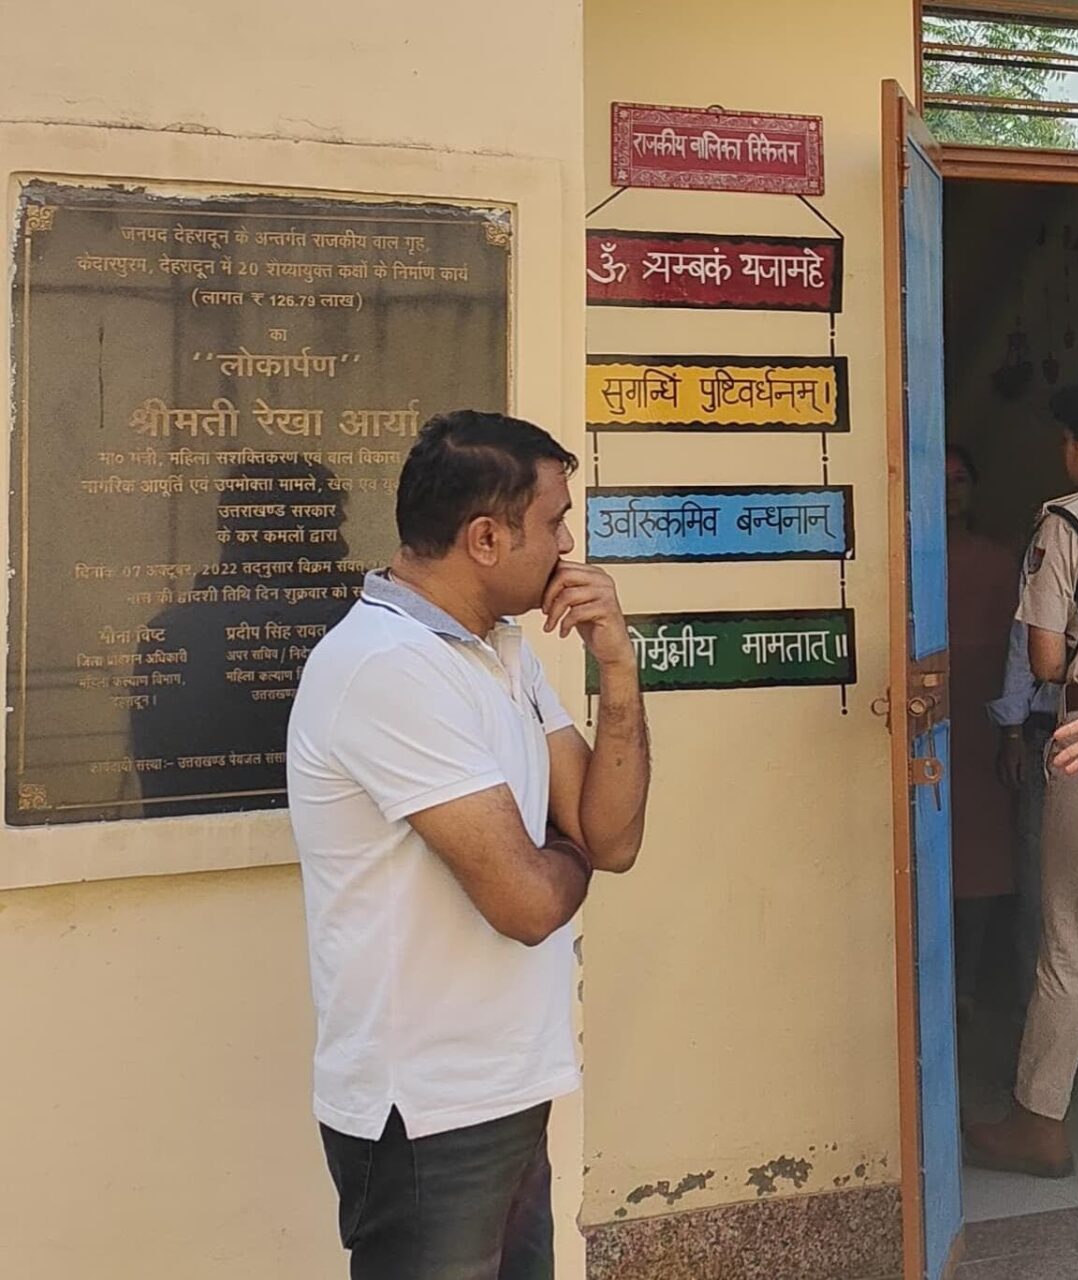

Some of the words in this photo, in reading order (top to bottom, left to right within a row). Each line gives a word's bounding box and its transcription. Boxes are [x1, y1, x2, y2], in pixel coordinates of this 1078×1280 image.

[633, 128, 688, 159] राजकीय
[120, 225, 168, 243] जनपद
[173, 223, 229, 249] देहरादून
[233, 225, 248, 244] के
[255, 227, 306, 247] अन्तर्गत
[312, 229, 367, 249] राजकीय
[158, 253, 215, 279] देहरादून
[219, 256, 233, 275] में
[238, 263, 258, 276] 20
[373, 260, 388, 278] के
[392, 261, 435, 280] निर्माण
[439, 263, 469, 281] कार्य
[739, 247, 825, 288] यजामहे
[191, 287, 243, 307] (लागत
[269, 294, 316, 307] 126.79
[319, 292, 363, 312] लाख)
[269, 328, 287, 342] का
[129, 397, 240, 437] श्रीमती
[252, 398, 324, 437] रेखा
[339, 399, 421, 438] आर्या
[168, 447, 210, 466] महिला
[189, 475, 209, 494] एवं
[278, 474, 323, 494] मामले,
[217, 504, 286, 518] उत्तराखण्ड
[290, 504, 337, 518] सरकार
[216, 525, 231, 543] के
[235, 529, 258, 543] कर
[308, 529, 338, 544] द्वारा
[202, 563, 238, 576] 2022
[298, 556, 332, 574] विक्रम
[223, 585, 251, 602] तिथि
[256, 584, 279, 600] दिन
[283, 587, 329, 604] शुक्रवार
[331, 583, 348, 599] को
[225, 621, 260, 641] प्रदीप
[264, 620, 292, 640] सिंह
[295, 624, 327, 639] रावत
